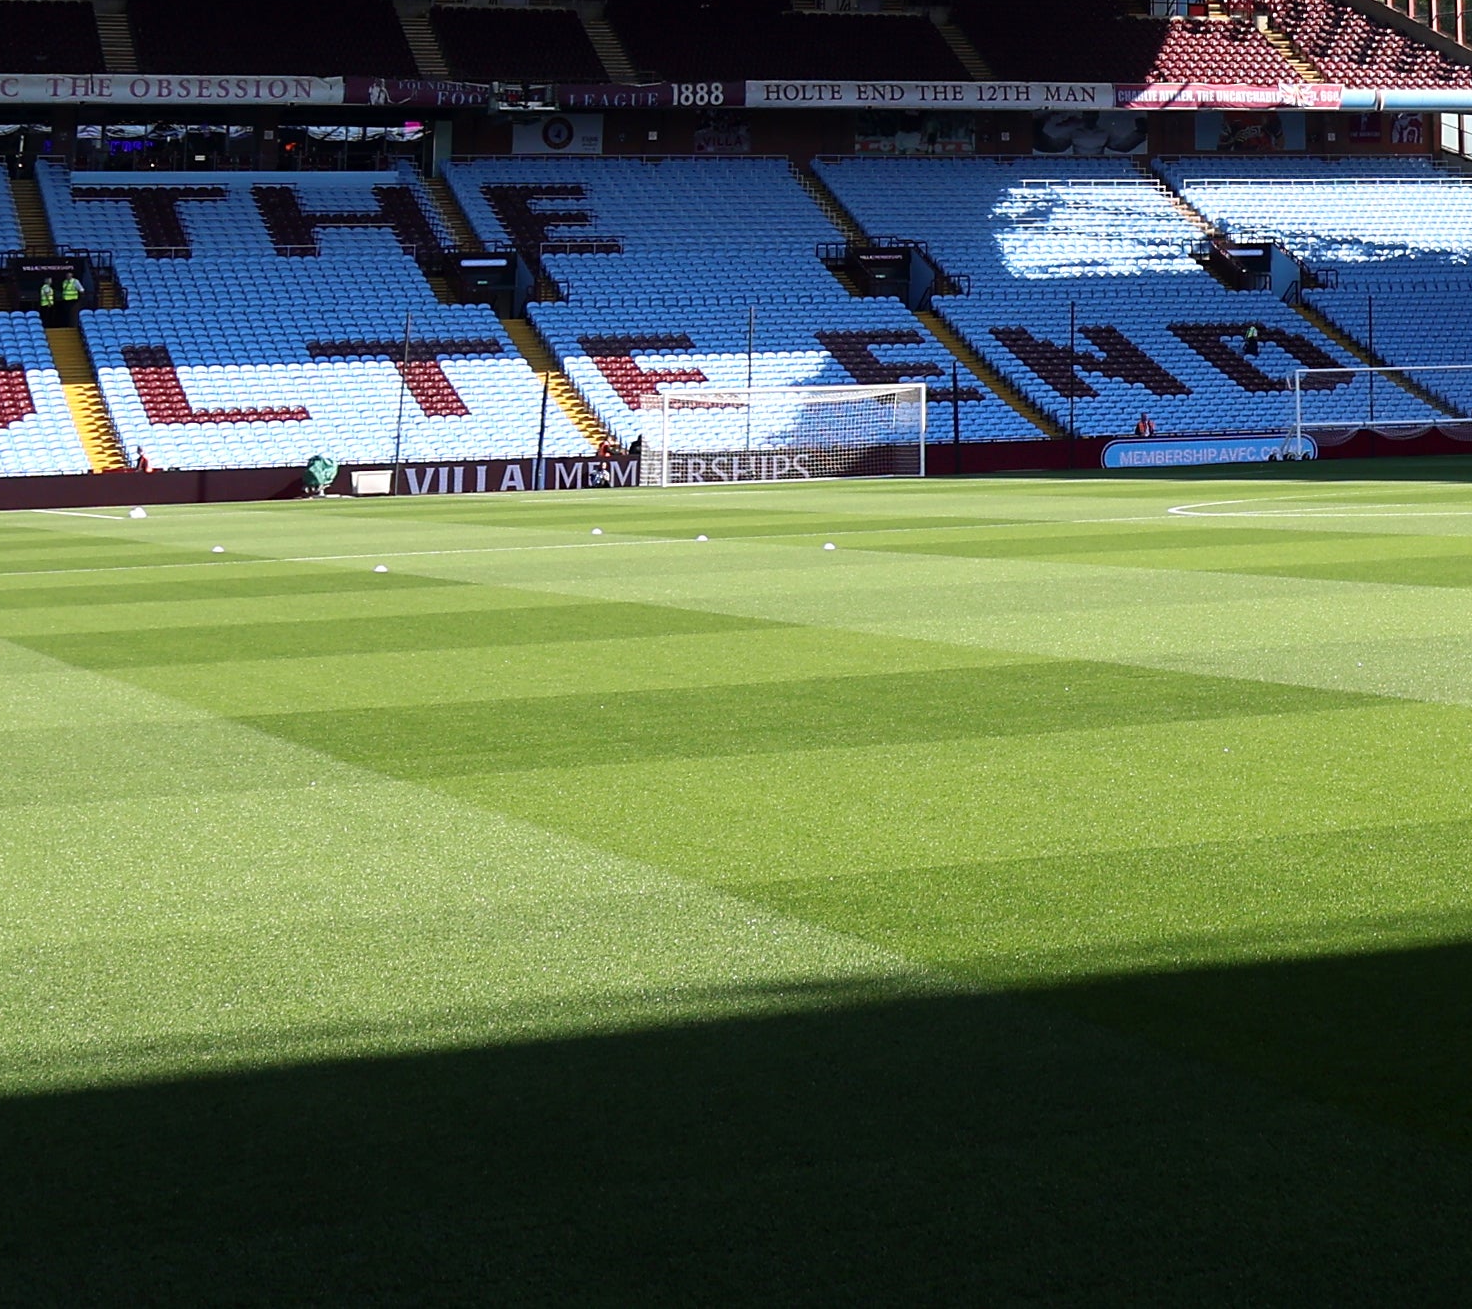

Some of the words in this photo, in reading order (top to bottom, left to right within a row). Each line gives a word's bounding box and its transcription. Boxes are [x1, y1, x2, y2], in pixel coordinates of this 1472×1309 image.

[48, 76, 113, 98] THE
[129, 76, 313, 99] OBSESSION
[569, 92, 659, 106] LEAGUE
[671, 82, 725, 106] 1888
[764, 84, 842, 101] HOLTE
[856, 85, 905, 101] END
[916, 86, 964, 101] THE
[977, 85, 1031, 102] 12TH
[1044, 86, 1097, 102] MAN
[1117, 90, 1159, 102] CHARLIE
[1196, 90, 1215, 102] THE
[1216, 90, 1281, 102] UNCATCHABL
[71, 184, 623, 261] THE
[814, 323, 1356, 398] END
[1119, 444, 1302, 465] MEMBERSHIP.AVFC.CO.
[405, 460, 526, 495] VILLA
[554, 453, 811, 490] MMERSHIPS
